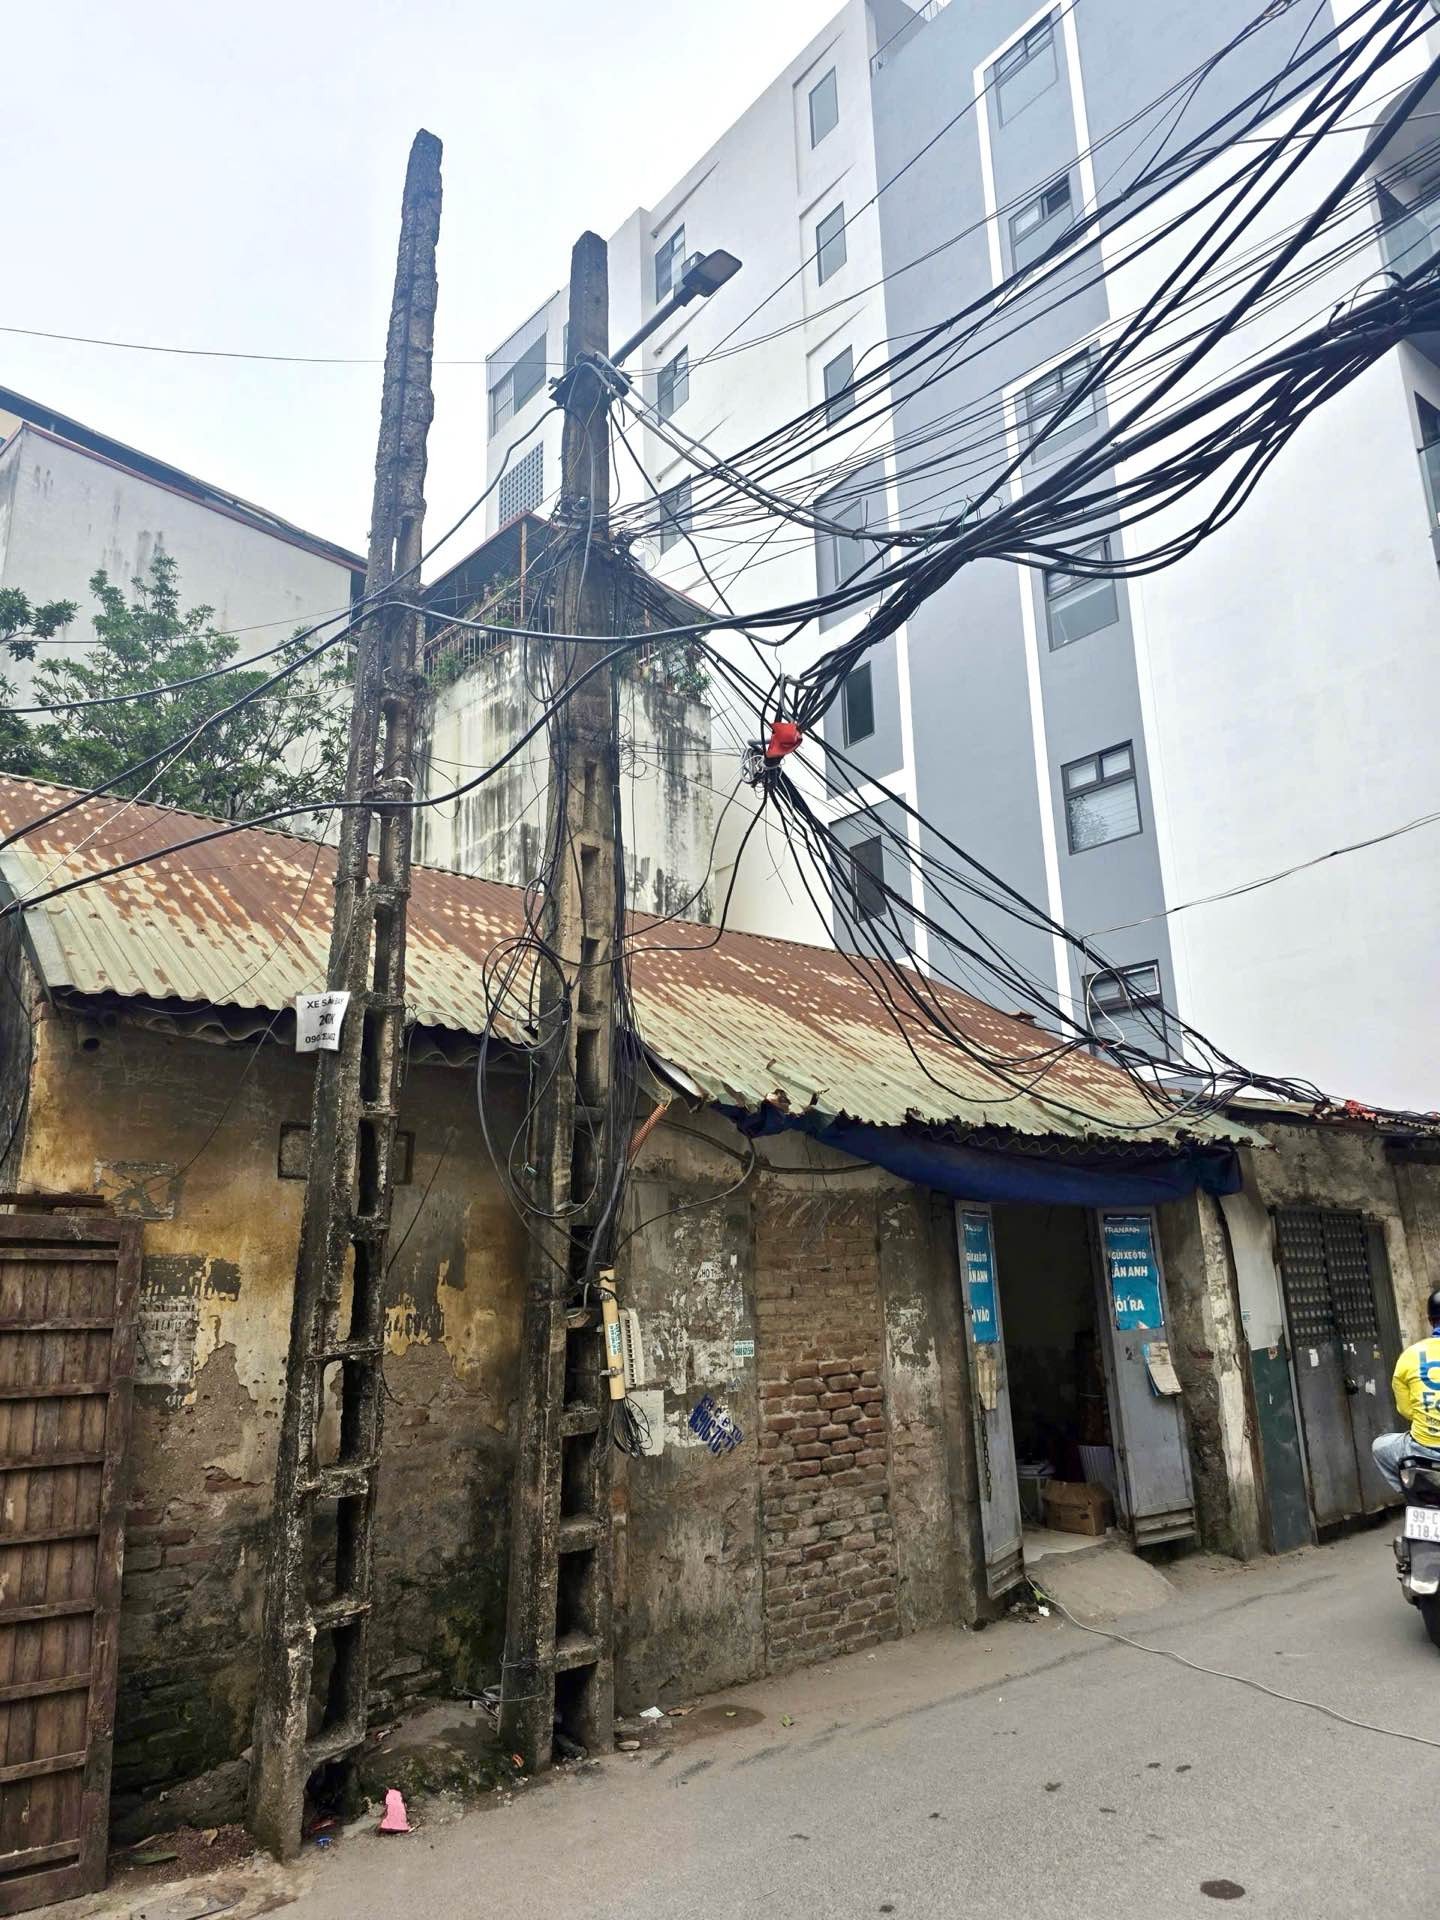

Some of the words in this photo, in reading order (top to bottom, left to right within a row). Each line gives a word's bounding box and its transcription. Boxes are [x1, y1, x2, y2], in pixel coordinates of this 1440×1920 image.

[307, 1000, 320, 1009] XE
[1127, 1266, 1149, 1277] ANH
[1129, 1298, 1145, 1311] RA
